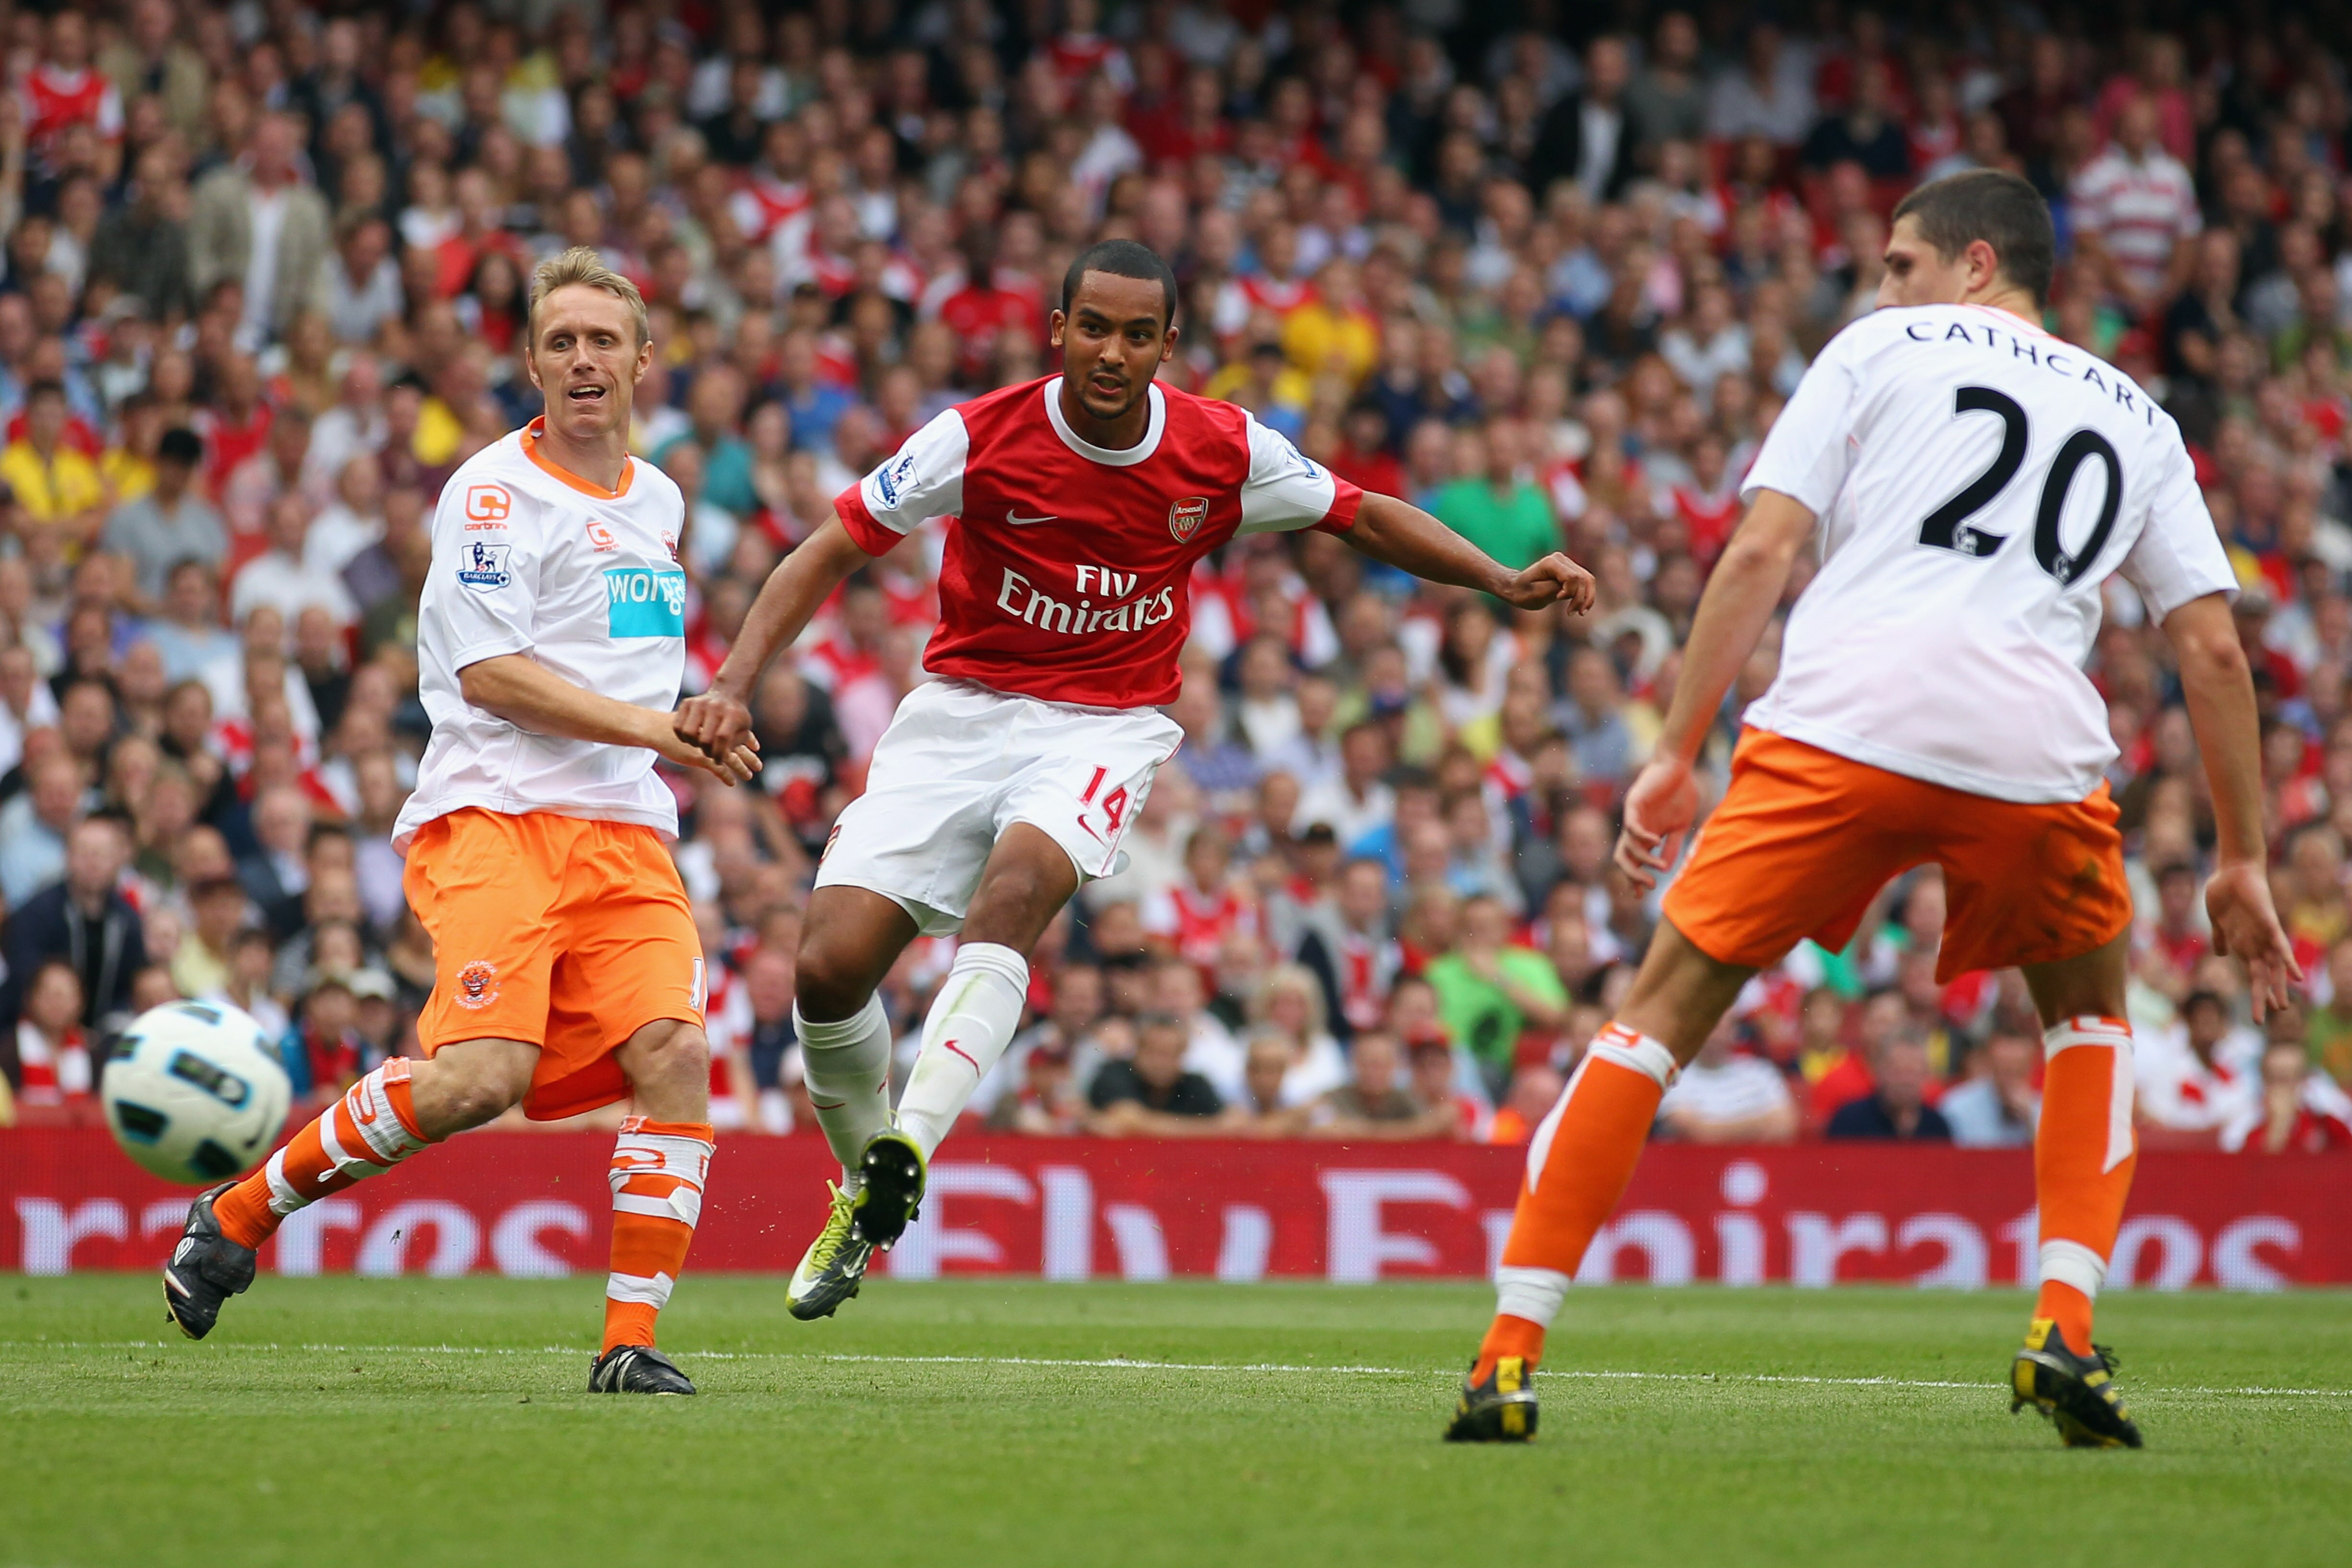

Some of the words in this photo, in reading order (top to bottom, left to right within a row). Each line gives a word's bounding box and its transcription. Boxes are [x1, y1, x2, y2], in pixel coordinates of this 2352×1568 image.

[1906, 322, 2160, 426] CATHCART
[1176, 504, 1202, 514] Arsenal
[1917, 384, 2125, 589] 20
[996, 567, 1174, 635] Emirates
[1075, 564, 1137, 600] Fly
[1077, 765, 1129, 840] 14
